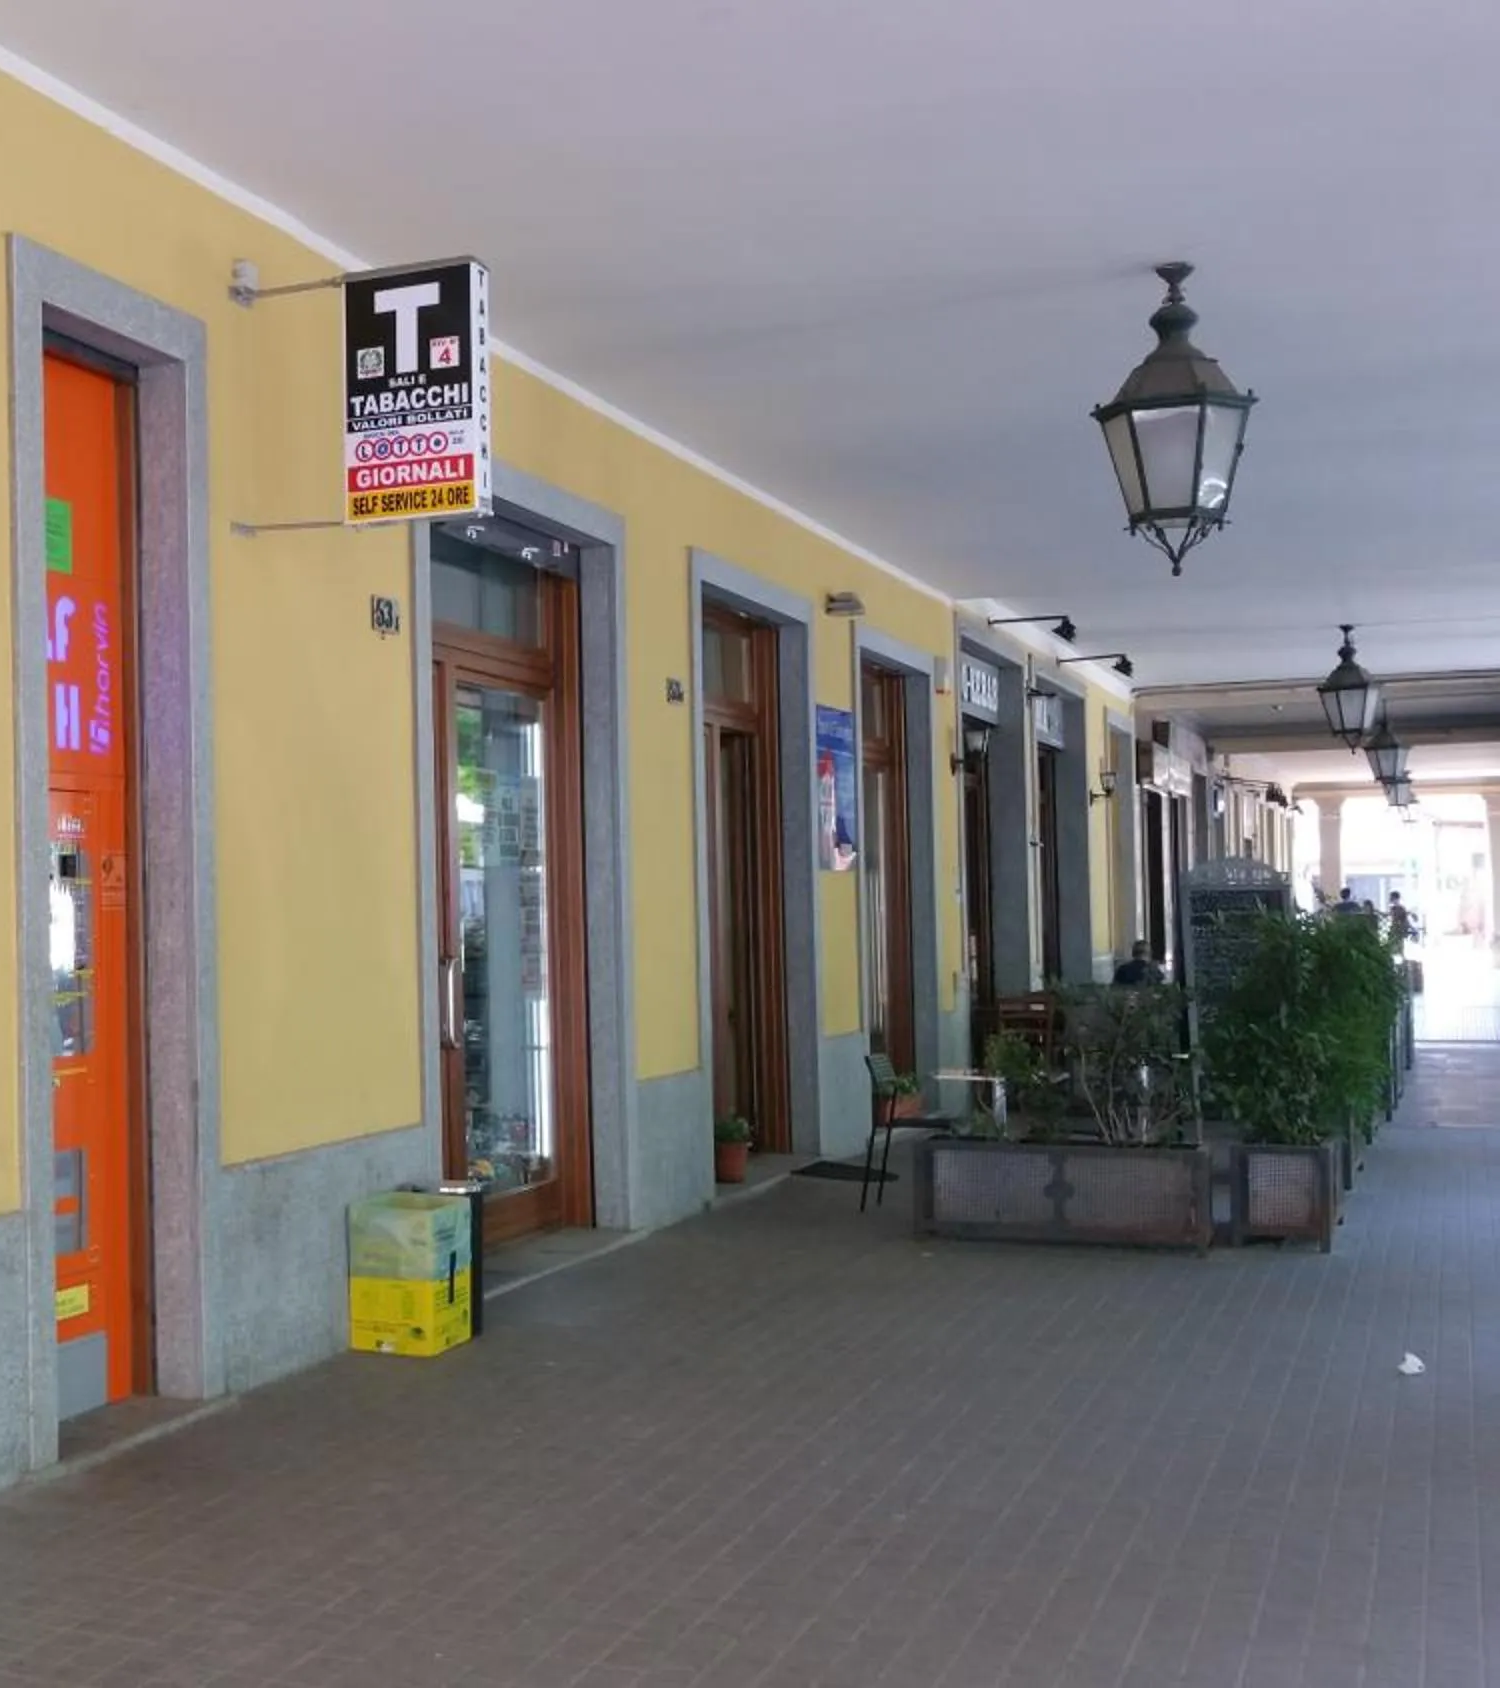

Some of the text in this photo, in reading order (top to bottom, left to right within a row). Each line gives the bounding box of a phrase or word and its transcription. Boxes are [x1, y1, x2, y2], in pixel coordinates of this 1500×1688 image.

[374, 282, 440, 374] T
[438, 347, 452, 364] 4
[350, 382, 469, 417] TABACCHI
[352, 407, 468, 432] VALORI BOLLATI
[356, 432, 448, 462] LOTTO
[355, 458, 466, 489] GIORNALI
[353, 486, 470, 516] SELF SERVICE 24 ORE
